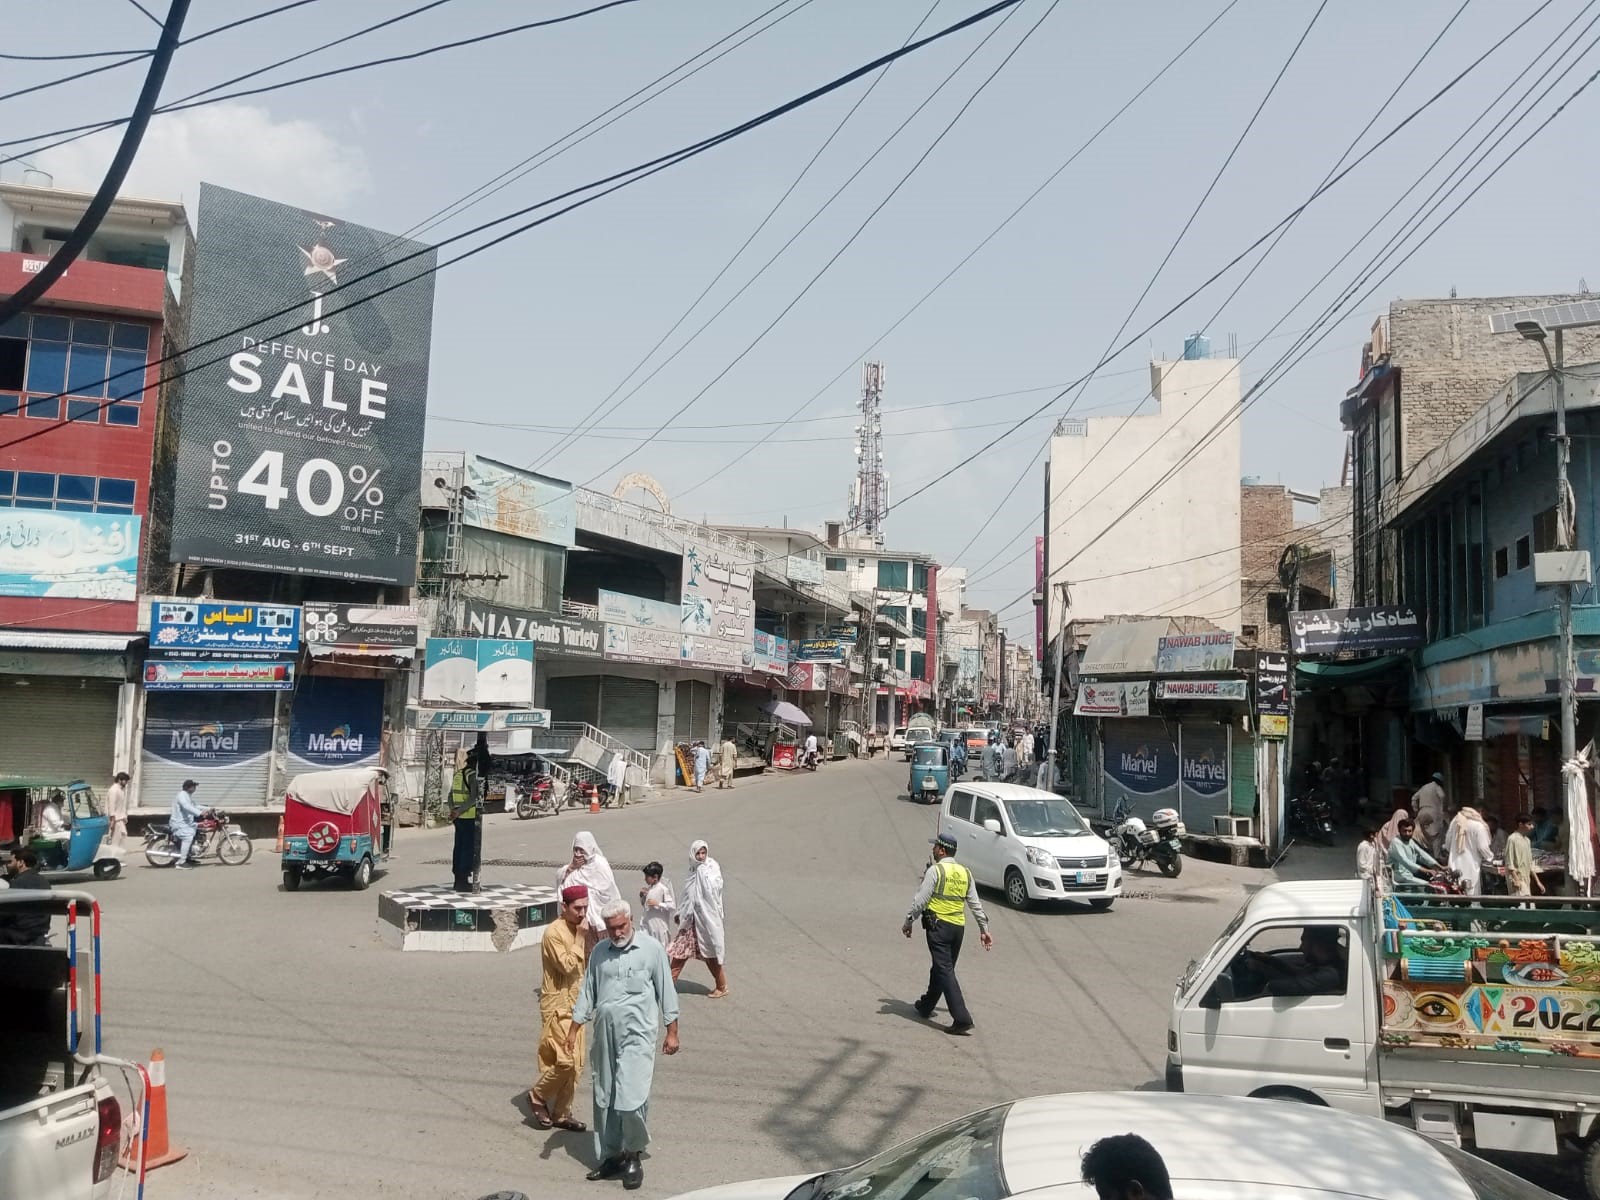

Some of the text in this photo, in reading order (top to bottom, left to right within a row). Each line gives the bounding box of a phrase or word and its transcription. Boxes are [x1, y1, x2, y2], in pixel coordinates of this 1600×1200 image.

[302, 290, 330, 336] J.
[243, 336, 381, 377] DEFENCE DAY
[227, 352, 388, 419] SALE
[274, 410, 296, 426] سلام
[238, 422, 263, 432] united
[273, 427, 301, 438] defend
[302, 433, 315, 441] our
[316, 435, 345, 446] beloved
[346, 441, 373, 452] country
[208, 440, 232, 510] UPTO
[344, 506, 384, 524] OFF
[352, 525, 361, 534] all
[262, 536, 291, 550] AUG
[302, 541, 321, 553] 6TH
[323, 544, 355, 557] SEPT
[203, 607, 253, 626] الیاس
[1386, 608, 1418, 626] شاہ
[231, 628, 263, 643] بستہ
[264, 628, 293, 644] بیگ
[469, 610, 600, 651] NIAZ Gents Variety
[1166, 633, 1233, 650] NAWAB JUICE
[1259, 656, 1288, 671] شاہ
[1167, 683, 1218, 694] NAWAB JUICE
[441, 713, 478, 723] FUJIFILM
[170, 730, 239, 749] Marvel
[308, 733, 363, 751] Marvel
[1121, 753, 1157, 774] Marvel
[1184, 759, 1226, 780] Marvel
[1511, 995, 1600, 1031] 2022
